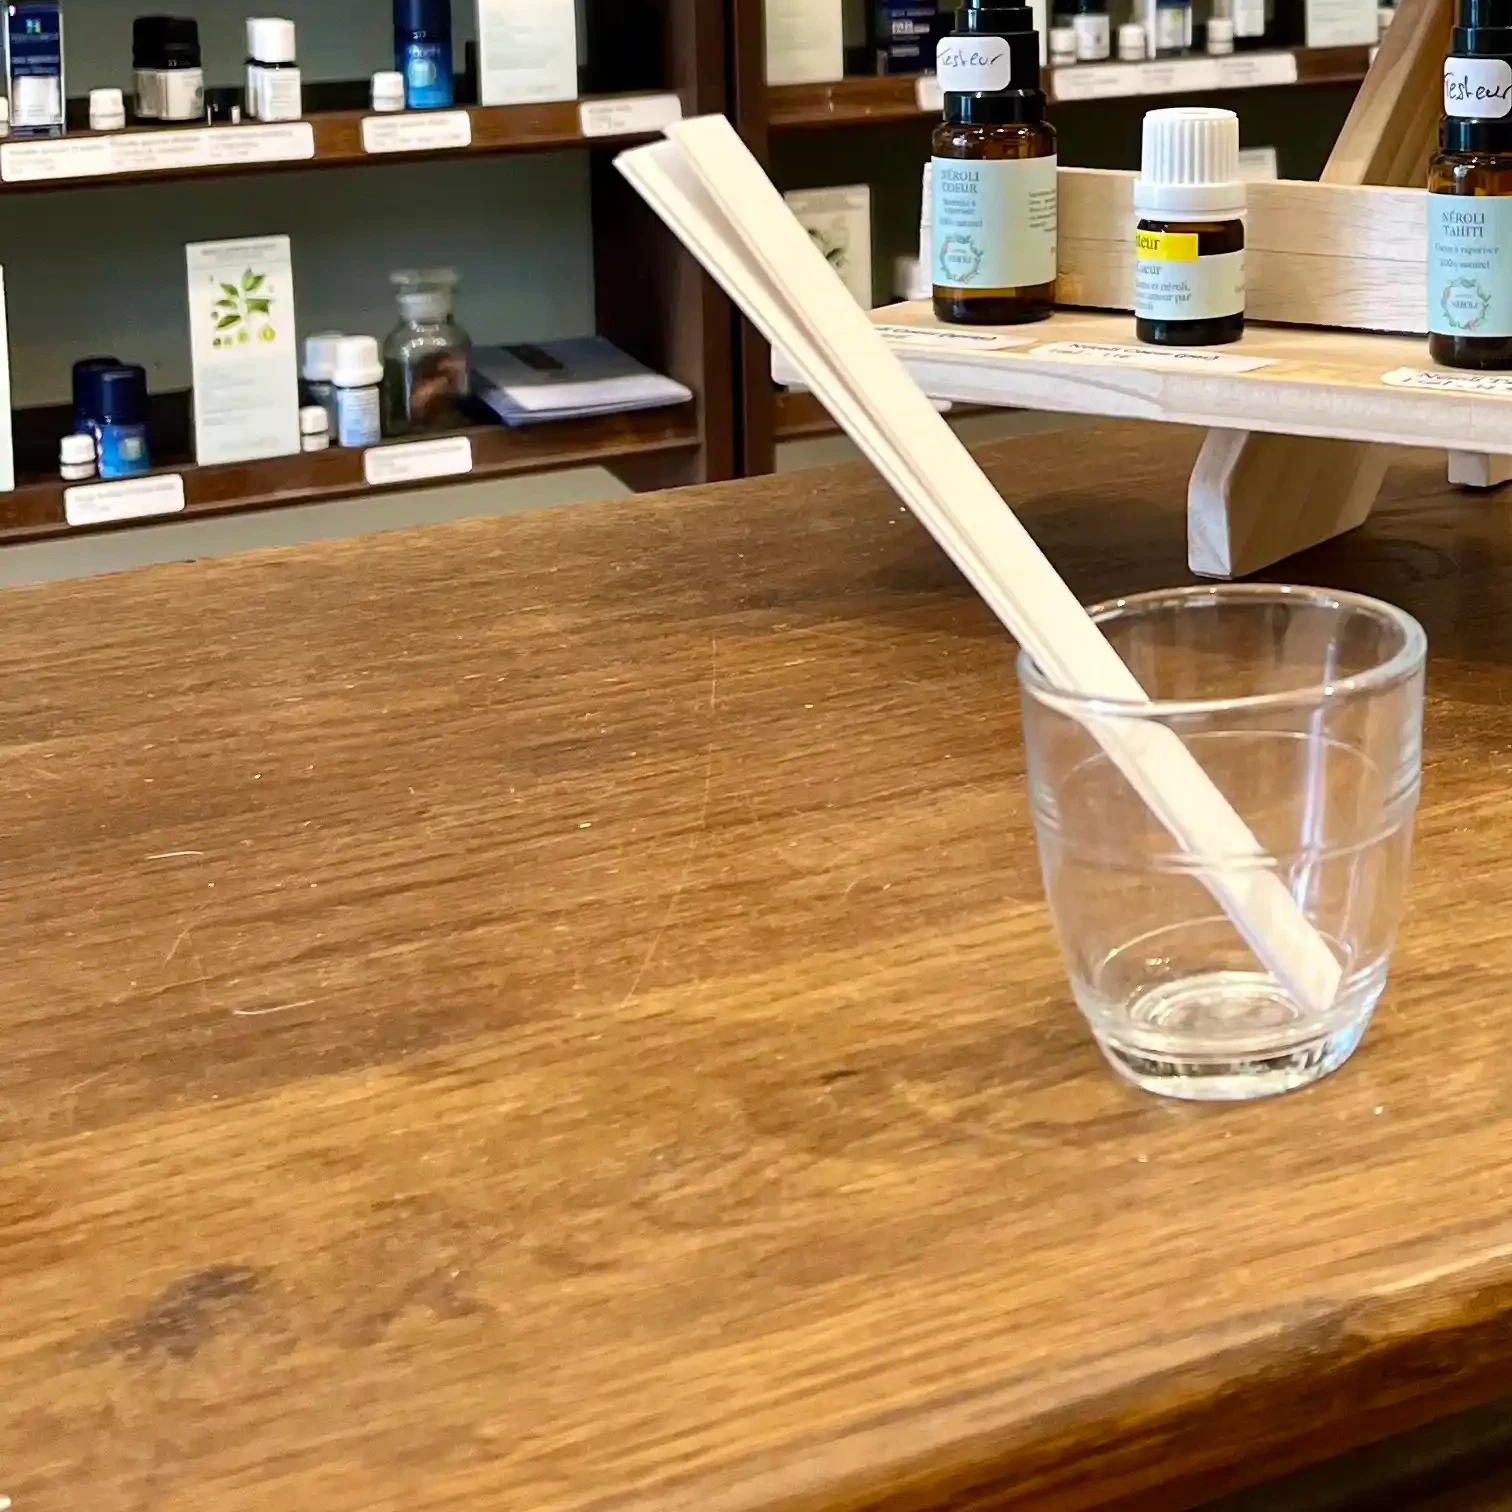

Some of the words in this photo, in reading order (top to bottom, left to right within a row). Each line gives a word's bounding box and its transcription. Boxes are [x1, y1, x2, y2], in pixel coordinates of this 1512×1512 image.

[1442, 209, 1486, 225] NÉROLI
[1443, 225, 1484, 238] TAHITI
[1136, 233, 1160, 251] teur
